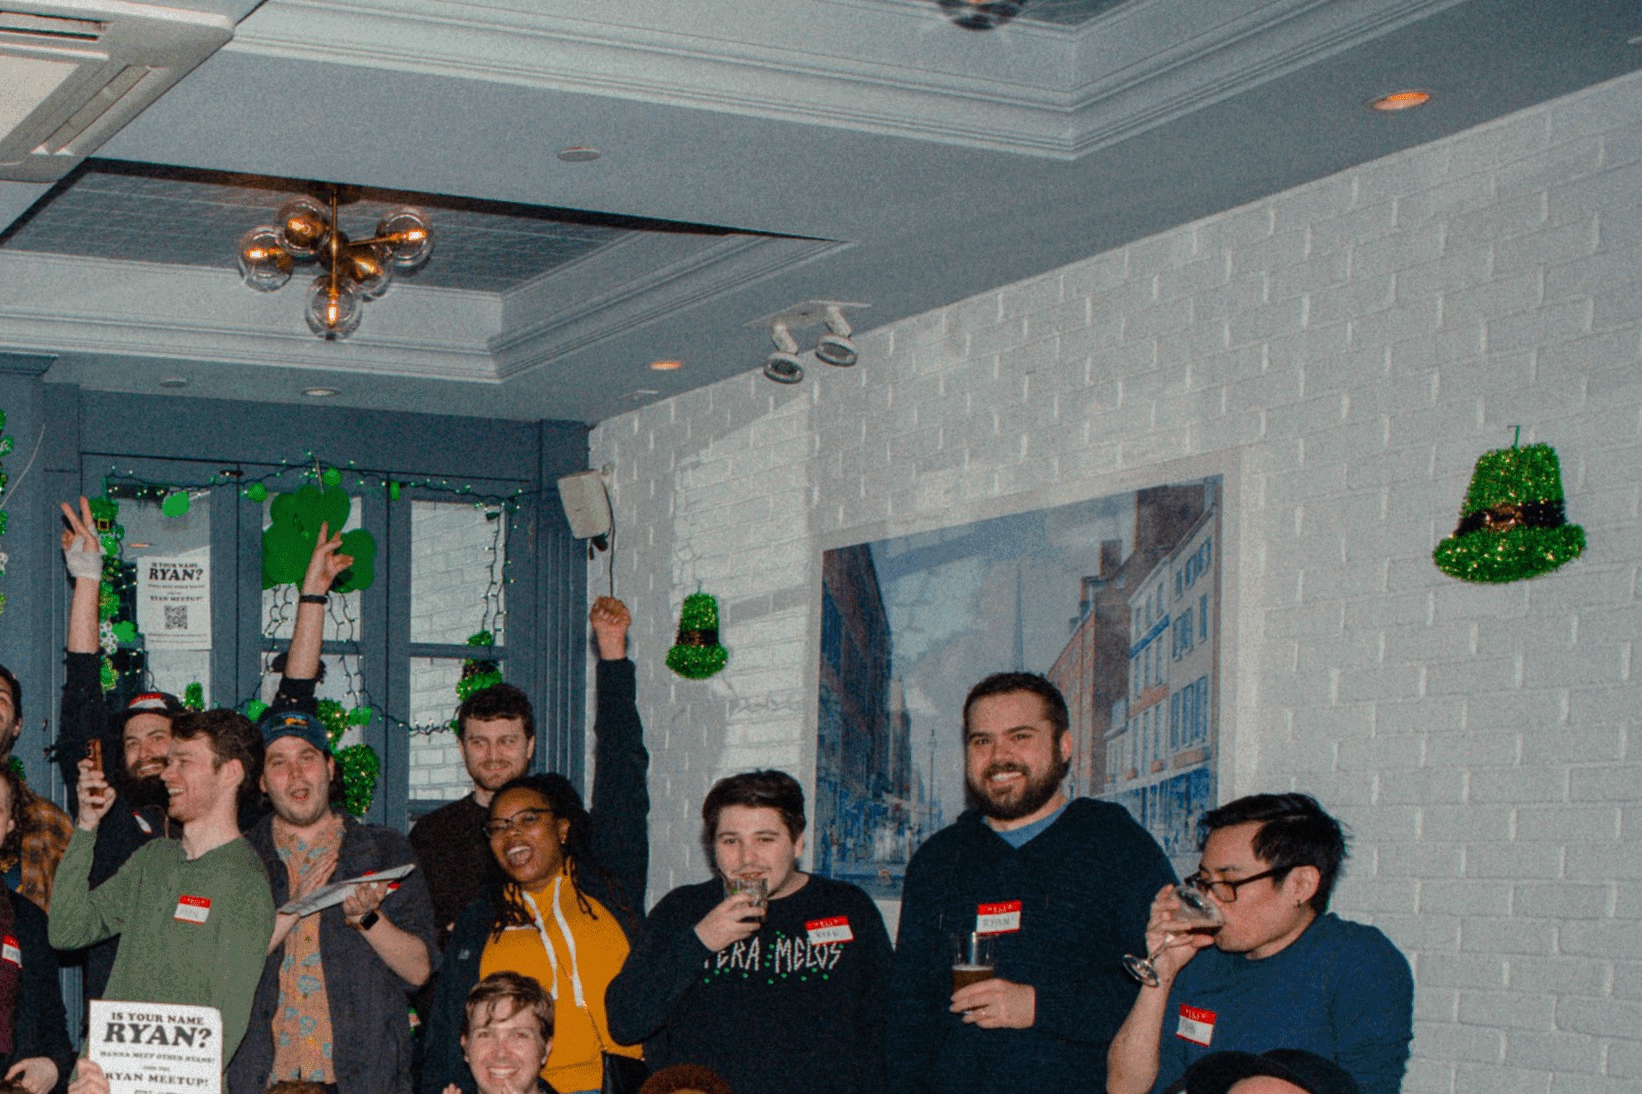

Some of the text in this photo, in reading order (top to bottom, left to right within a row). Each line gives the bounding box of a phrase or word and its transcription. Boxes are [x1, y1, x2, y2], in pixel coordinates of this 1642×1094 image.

[149, 568, 203, 581] RYAN?
[775, 936, 842, 973] MELOS
[111, 1012, 204, 1026] IS YOUR NAME
[103, 1022, 213, 1048] RYAN?
[105, 1072, 209, 1087] RYAN MEETUP!
